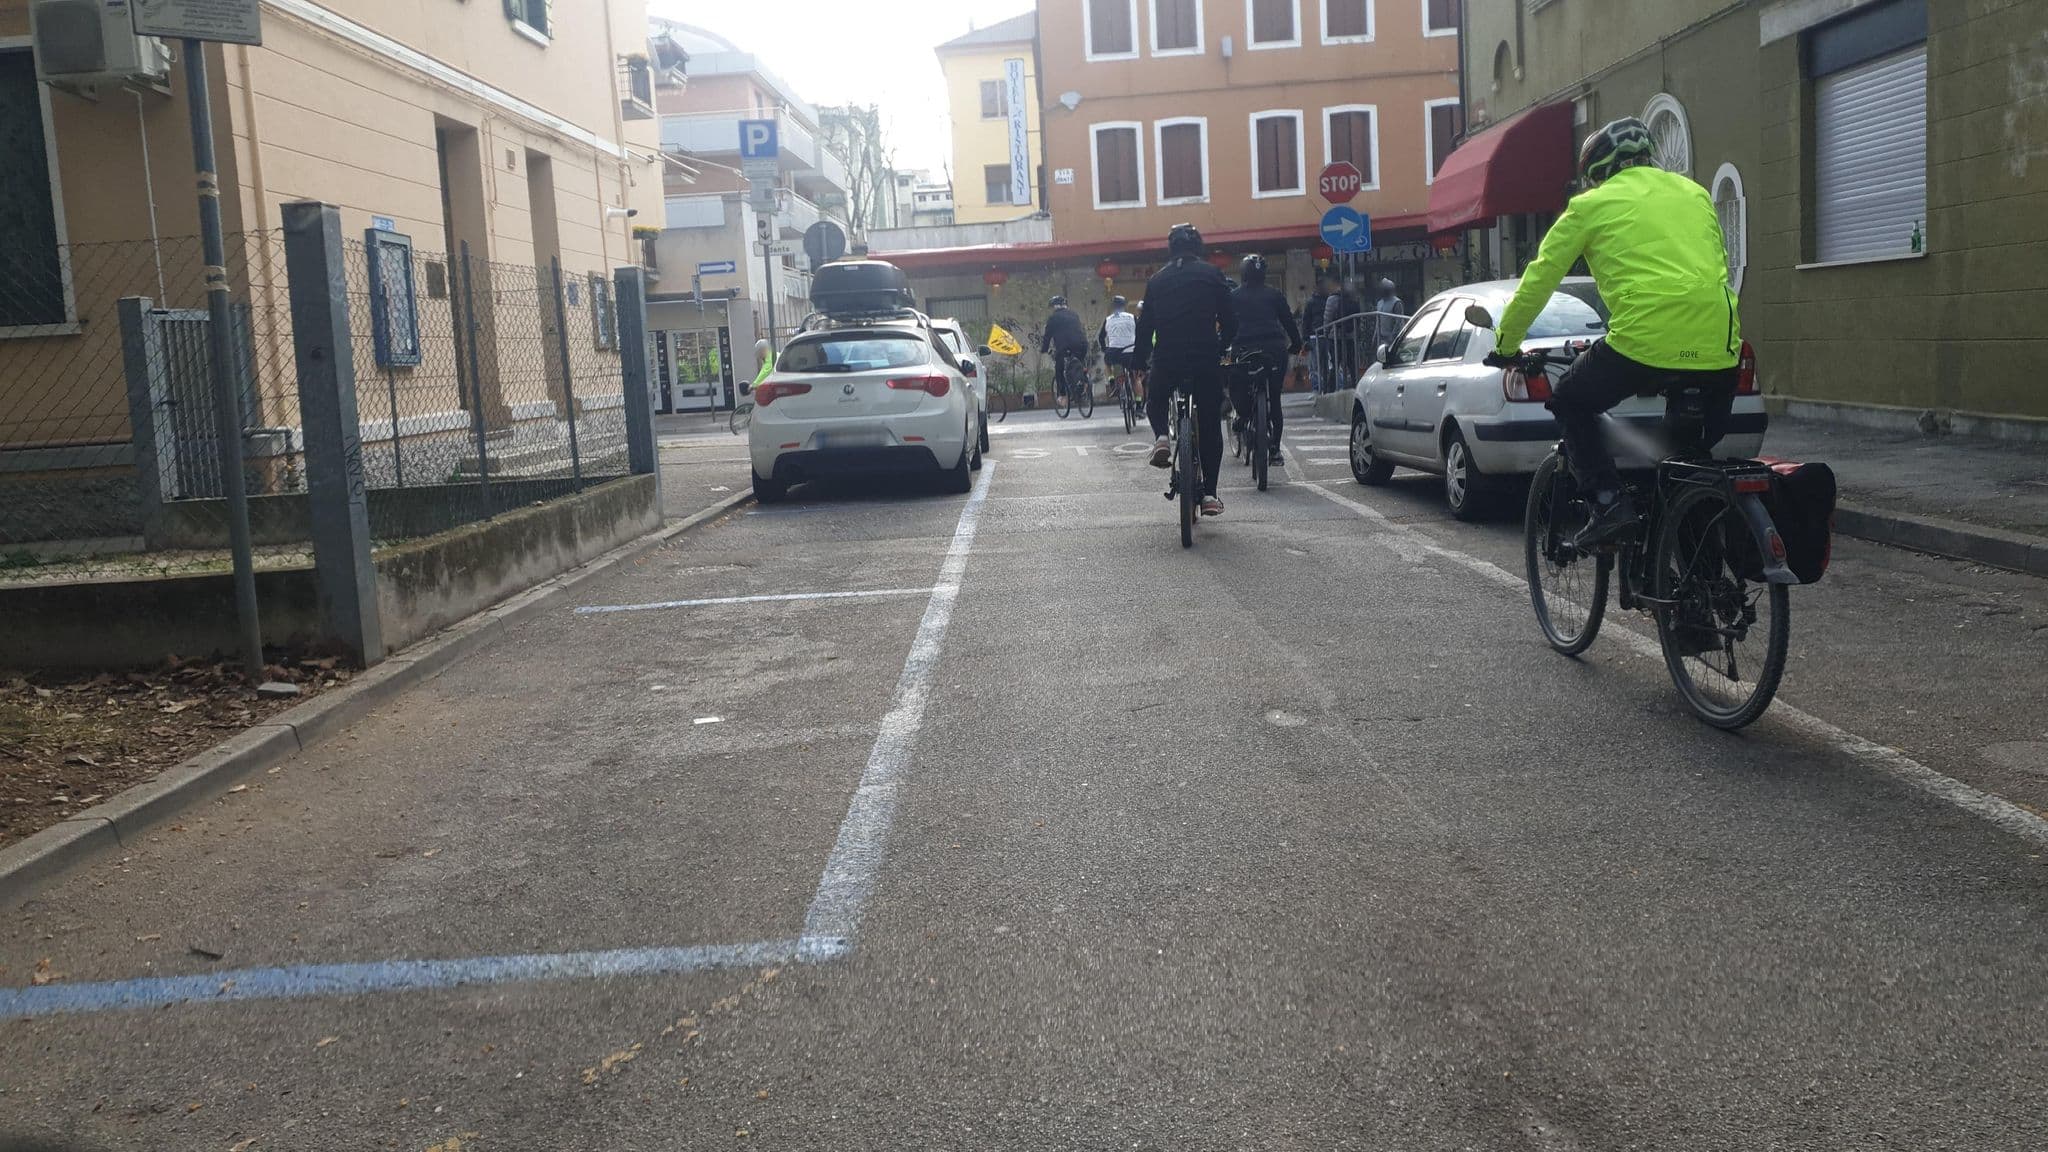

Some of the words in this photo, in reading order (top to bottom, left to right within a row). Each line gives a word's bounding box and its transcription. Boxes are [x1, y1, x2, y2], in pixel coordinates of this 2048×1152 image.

[1009, 61, 1018, 105] HOTEL
[747, 124, 769, 155] P
[1321, 175, 1358, 193] STOP
[1680, 350, 1699, 358] GORE
